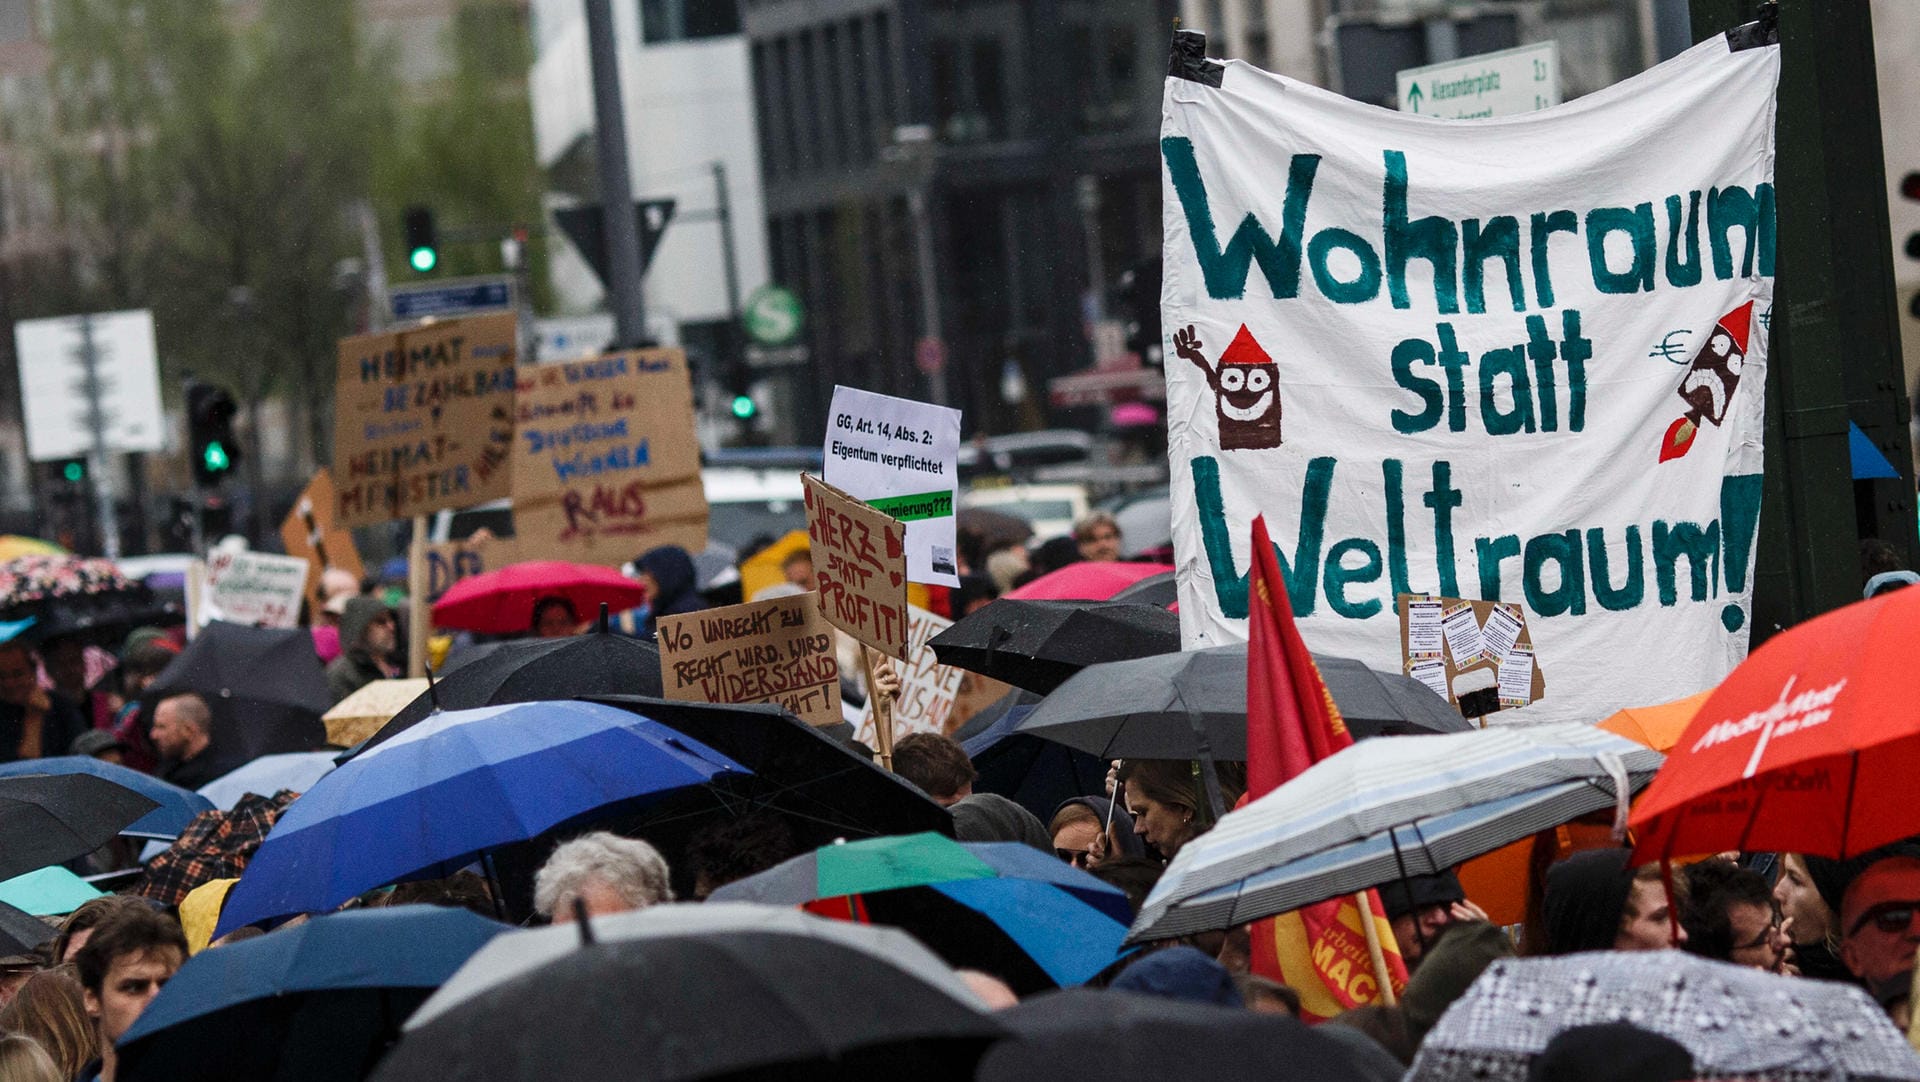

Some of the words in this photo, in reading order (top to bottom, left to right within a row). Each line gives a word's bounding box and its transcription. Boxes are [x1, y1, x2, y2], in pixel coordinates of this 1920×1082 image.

[1161, 135, 1775, 314] Wohnraum
[1391, 309, 1592, 436] statt
[832, 440, 878, 464] Eigentum
[881, 450, 943, 475] verpflichtet
[837, 413, 853, 433] GG,
[856, 417, 874, 435] Art.
[877, 421, 892, 441] 14,
[894, 425, 919, 443] Abs.
[922, 430, 933, 446] 2:
[816, 495, 885, 573] HERZ
[1191, 455, 1764, 633] Weltraum!
[827, 553, 872, 590] STATT
[701, 606, 778, 644] UNRECHT
[817, 571, 906, 660] PROFIT!
[673, 651, 731, 688] RECHT
[788, 633, 830, 659] WIRD
[701, 655, 838, 703] WIDERSTAND
[1311, 937, 1383, 1008] MAC
